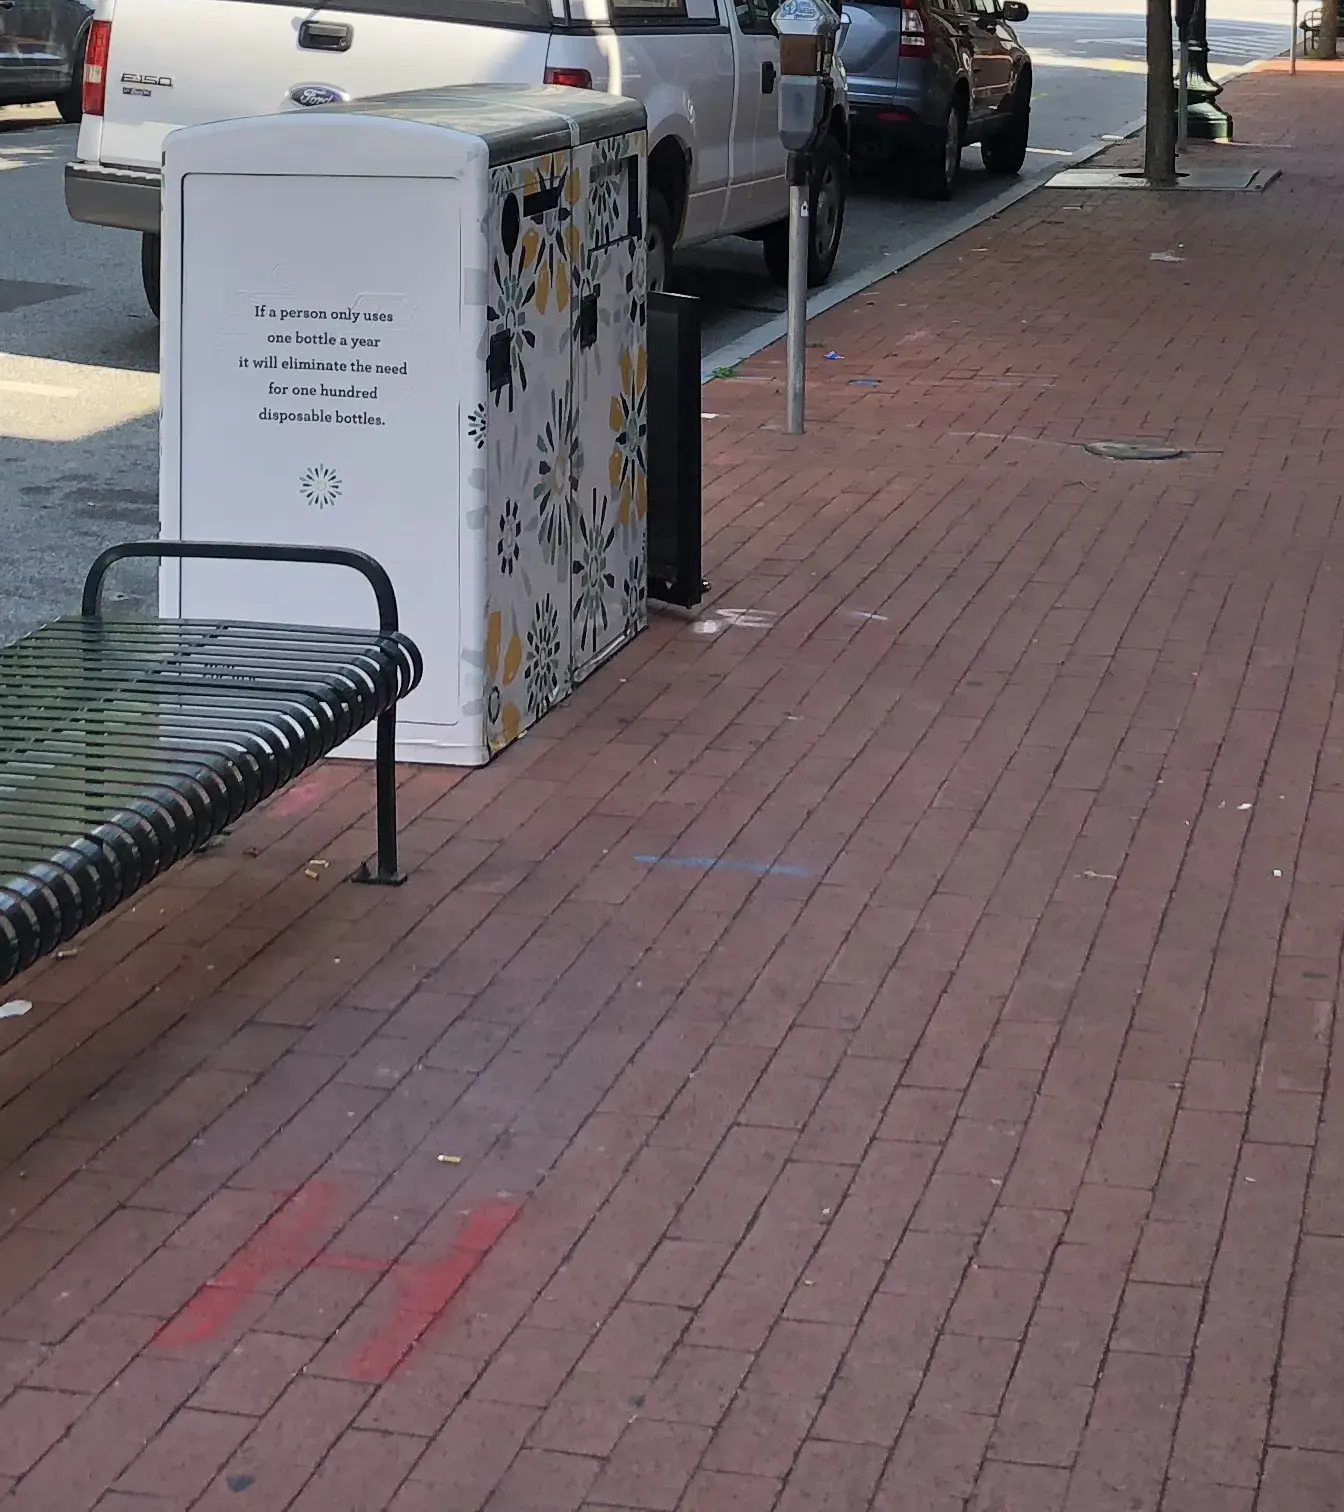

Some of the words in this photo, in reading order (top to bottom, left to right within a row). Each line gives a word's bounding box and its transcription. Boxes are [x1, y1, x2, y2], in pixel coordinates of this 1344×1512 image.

[299, 88, 334, 105] Ford
[254, 304, 267, 318] If
[268, 308, 277, 318] a
[279, 308, 328, 321] person
[330, 306, 361, 324] only
[363, 312, 394, 322] uses
[267, 333, 293, 344] one
[295, 330, 337, 346] bottle
[339, 337, 348, 346] a
[350, 337, 381, 350] year
[238, 356, 250, 368] it
[252, 355, 278, 369] will
[281, 355, 348, 372] eliminate
[349, 358, 373, 374] the
[375, 361, 408, 376] need
[268, 381, 289, 395] for
[291, 386, 317, 396] one
[319, 383, 378, 400] hundred
[258, 406, 333, 424] disposable
[335, 409, 386, 426] bottles.
